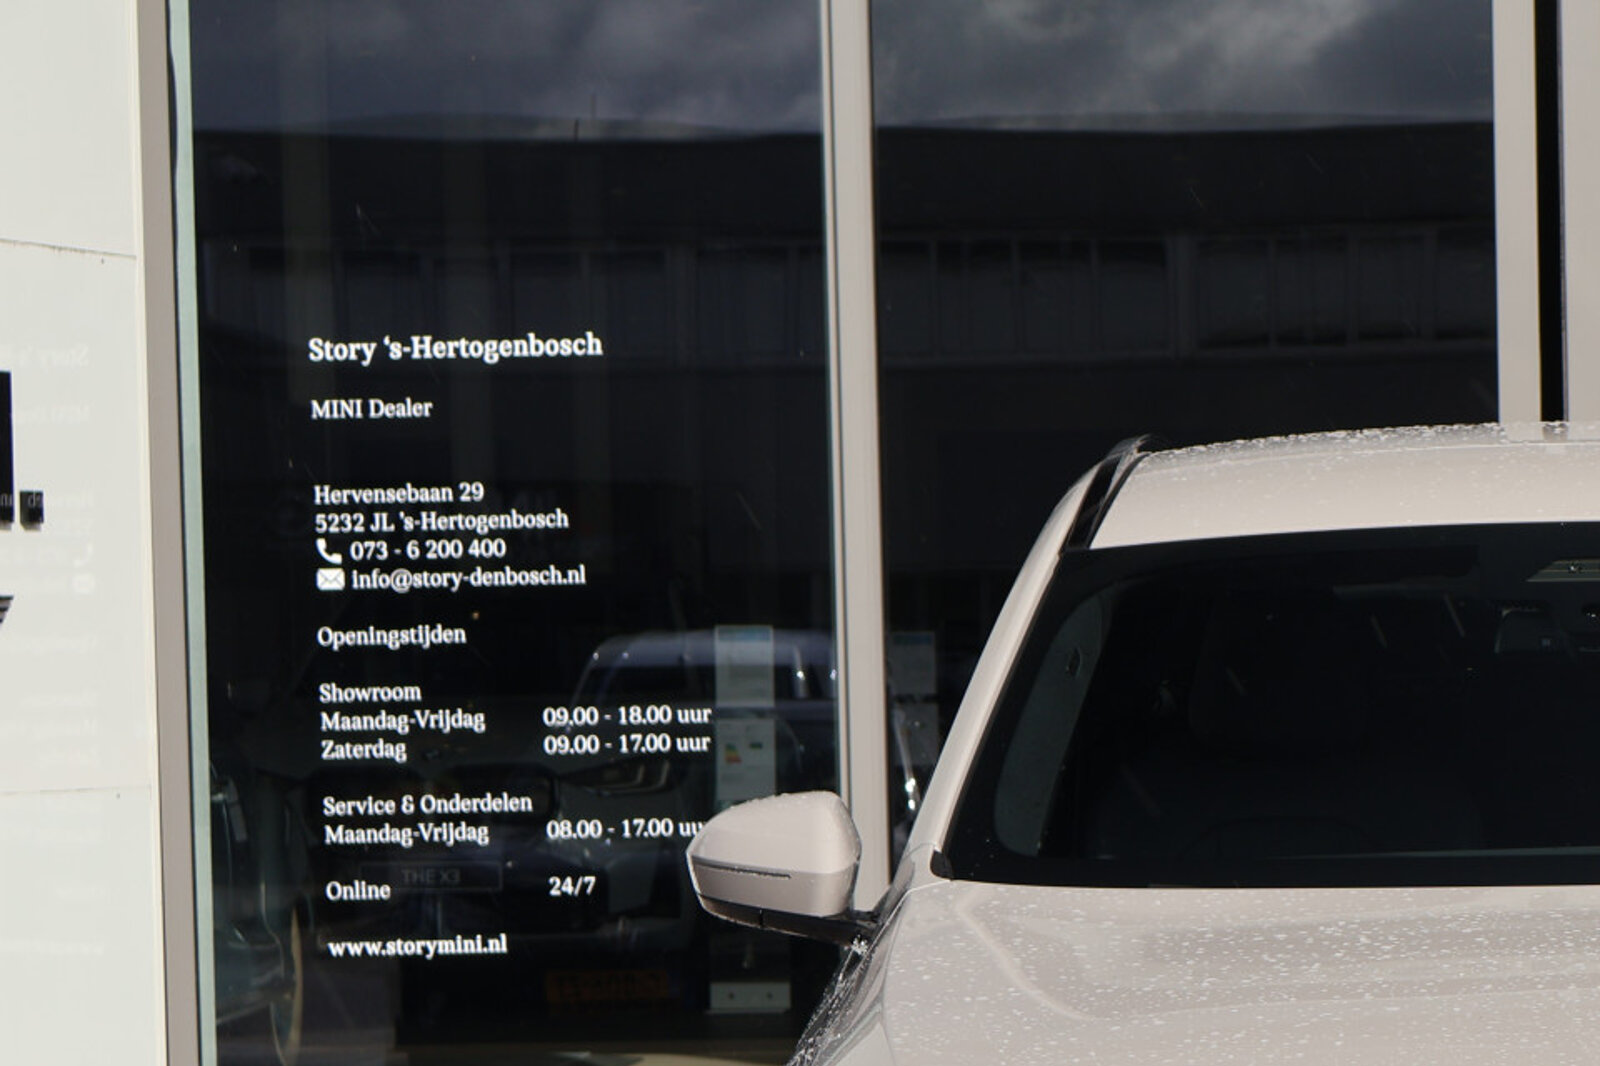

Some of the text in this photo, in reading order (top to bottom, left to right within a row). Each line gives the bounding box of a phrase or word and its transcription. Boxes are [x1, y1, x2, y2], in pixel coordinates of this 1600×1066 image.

[308, 337, 376, 366] Story
[312, 398, 432, 418] MINI Dealer
[314, 482, 484, 504] Hervensebaan 29
[315, 514, 364, 532] 5232
[370, 512, 394, 531] JL
[351, 541, 388, 559] 073
[407, 540, 419, 558] 6
[426, 540, 462, 558] 200
[469, 539, 506, 557] 400
[352, 566, 586, 592] info@story-denbosch.nl
[317, 625, 466, 650] Openingstijden
[319, 684, 421, 702] Showroom
[321, 709, 485, 734] Maandag-Vrijdag
[543, 708, 599, 726] 09.00
[618, 706, 672, 725] 18.00
[677, 710, 712, 724] uur
[321, 738, 407, 763] Zaterdag
[544, 736, 599, 754] 09.00
[619, 734, 671, 753] 17.00
[676, 738, 710, 752] uur
[323, 793, 532, 816] Service & Onderdelen
[324, 823, 489, 847] Maandag-Vrijdag
[547, 820, 601, 840] 08.00
[621, 818, 673, 838] 17.00
[679, 822, 704, 836] uu
[326, 877, 595, 901] Online 24/7
[328, 934, 507, 960] www.storymini.nl
